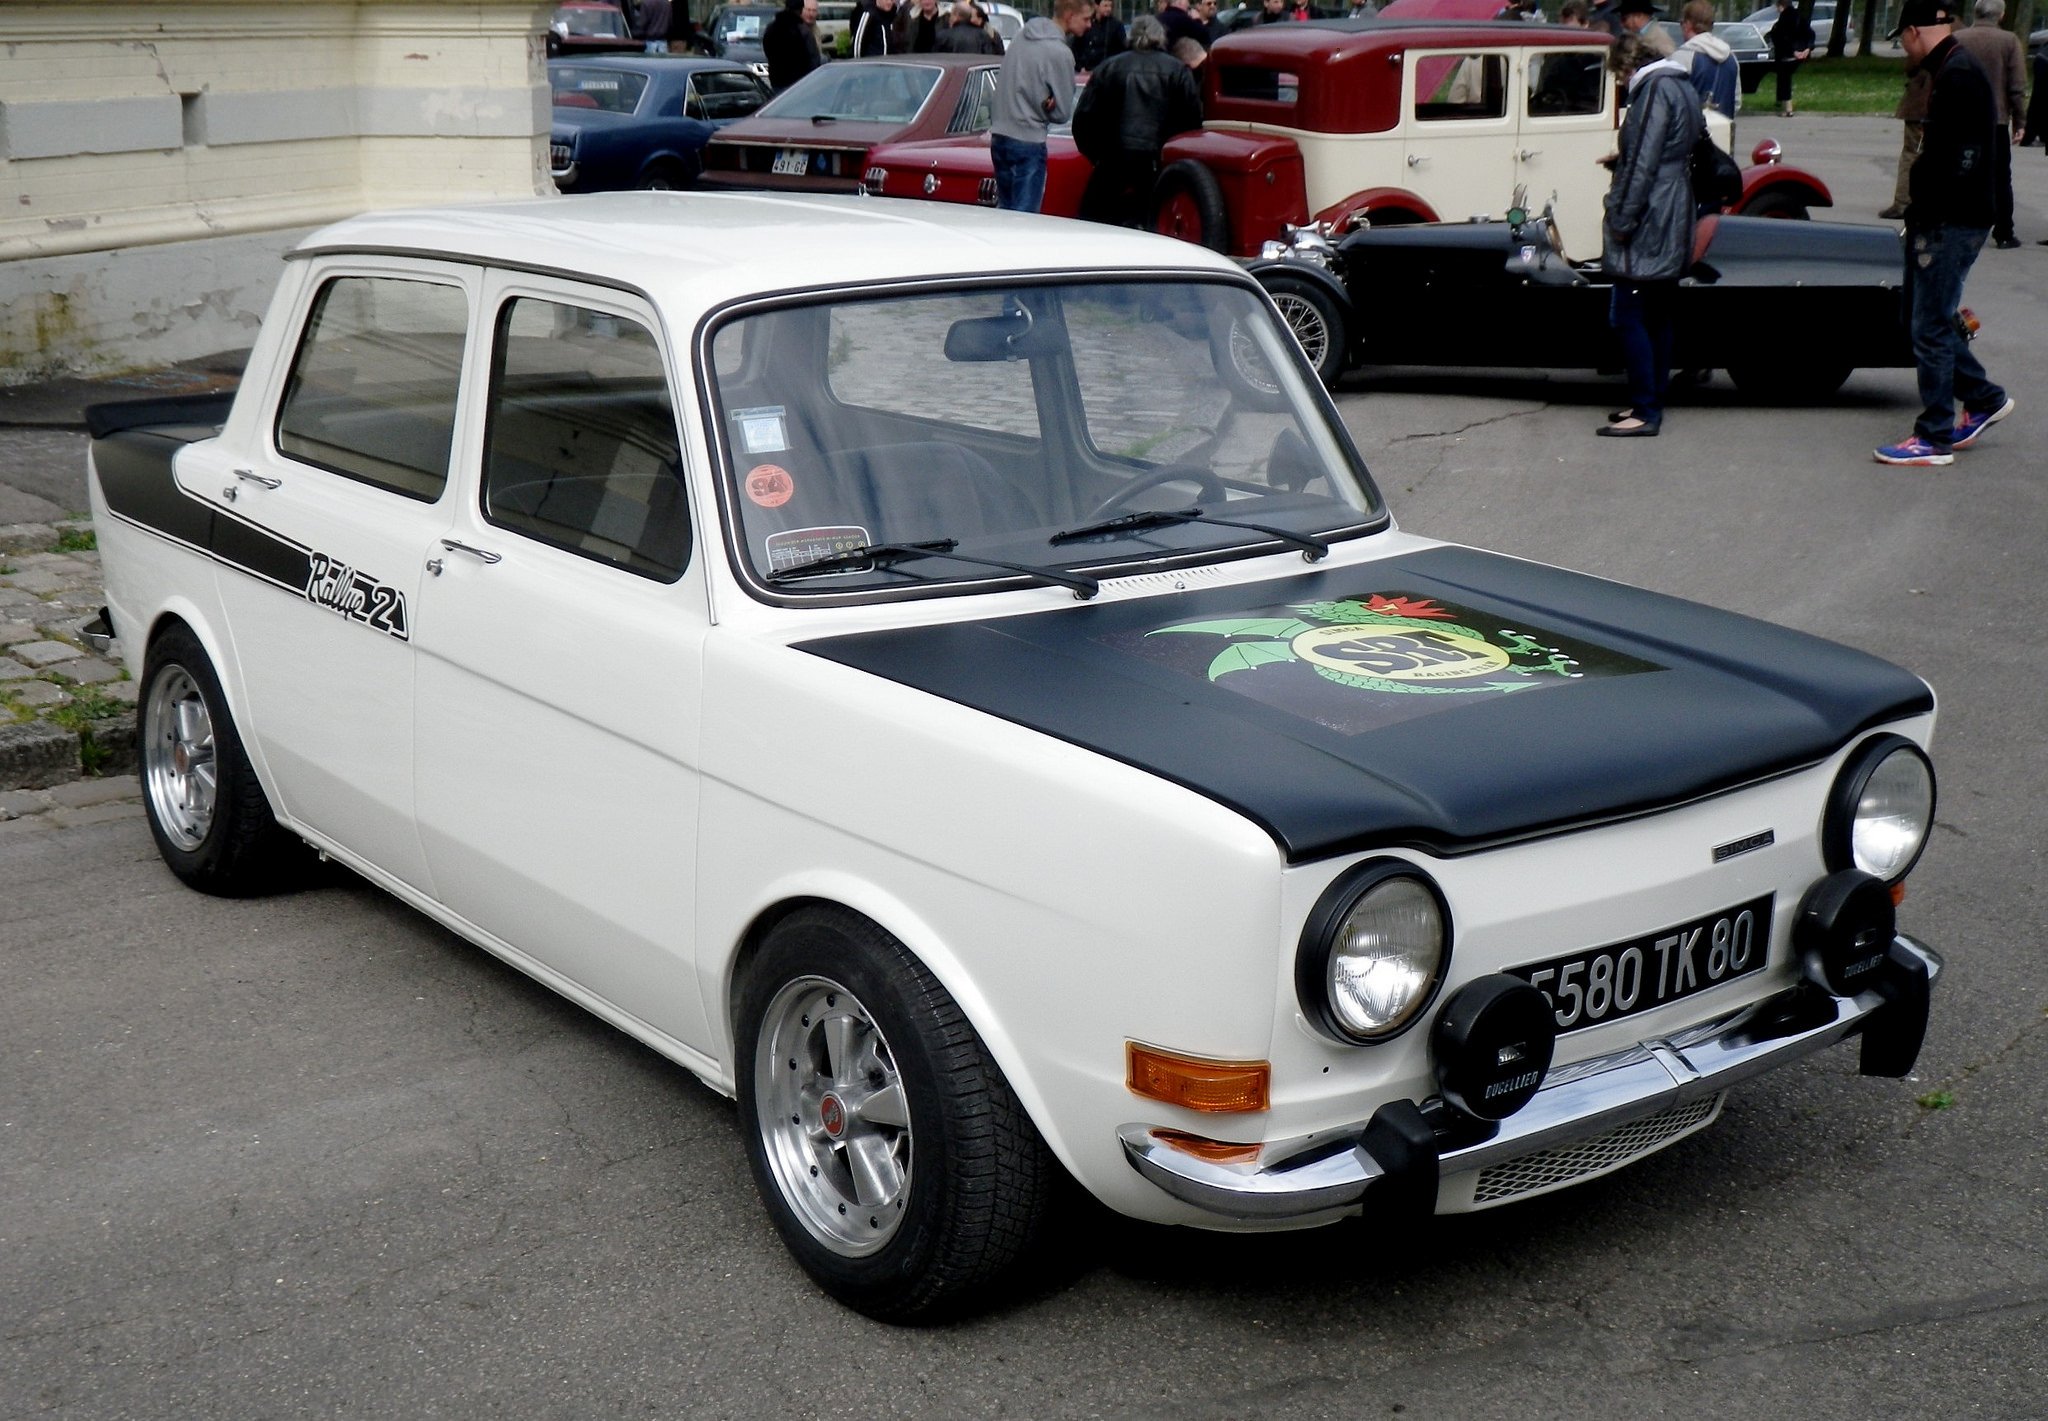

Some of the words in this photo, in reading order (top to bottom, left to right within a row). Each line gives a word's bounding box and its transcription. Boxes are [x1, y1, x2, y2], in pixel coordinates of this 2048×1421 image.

[369, 586, 397, 632] 2
[1311, 630, 1491, 675] SRT
[1413, 668, 1470, 678] RACING
[1716, 832, 1774, 859] SIMCA
[1655, 927, 1703, 999] TK
[1708, 909, 1754, 980] 80
[1485, 1070, 1539, 1100] DUCELLIER
